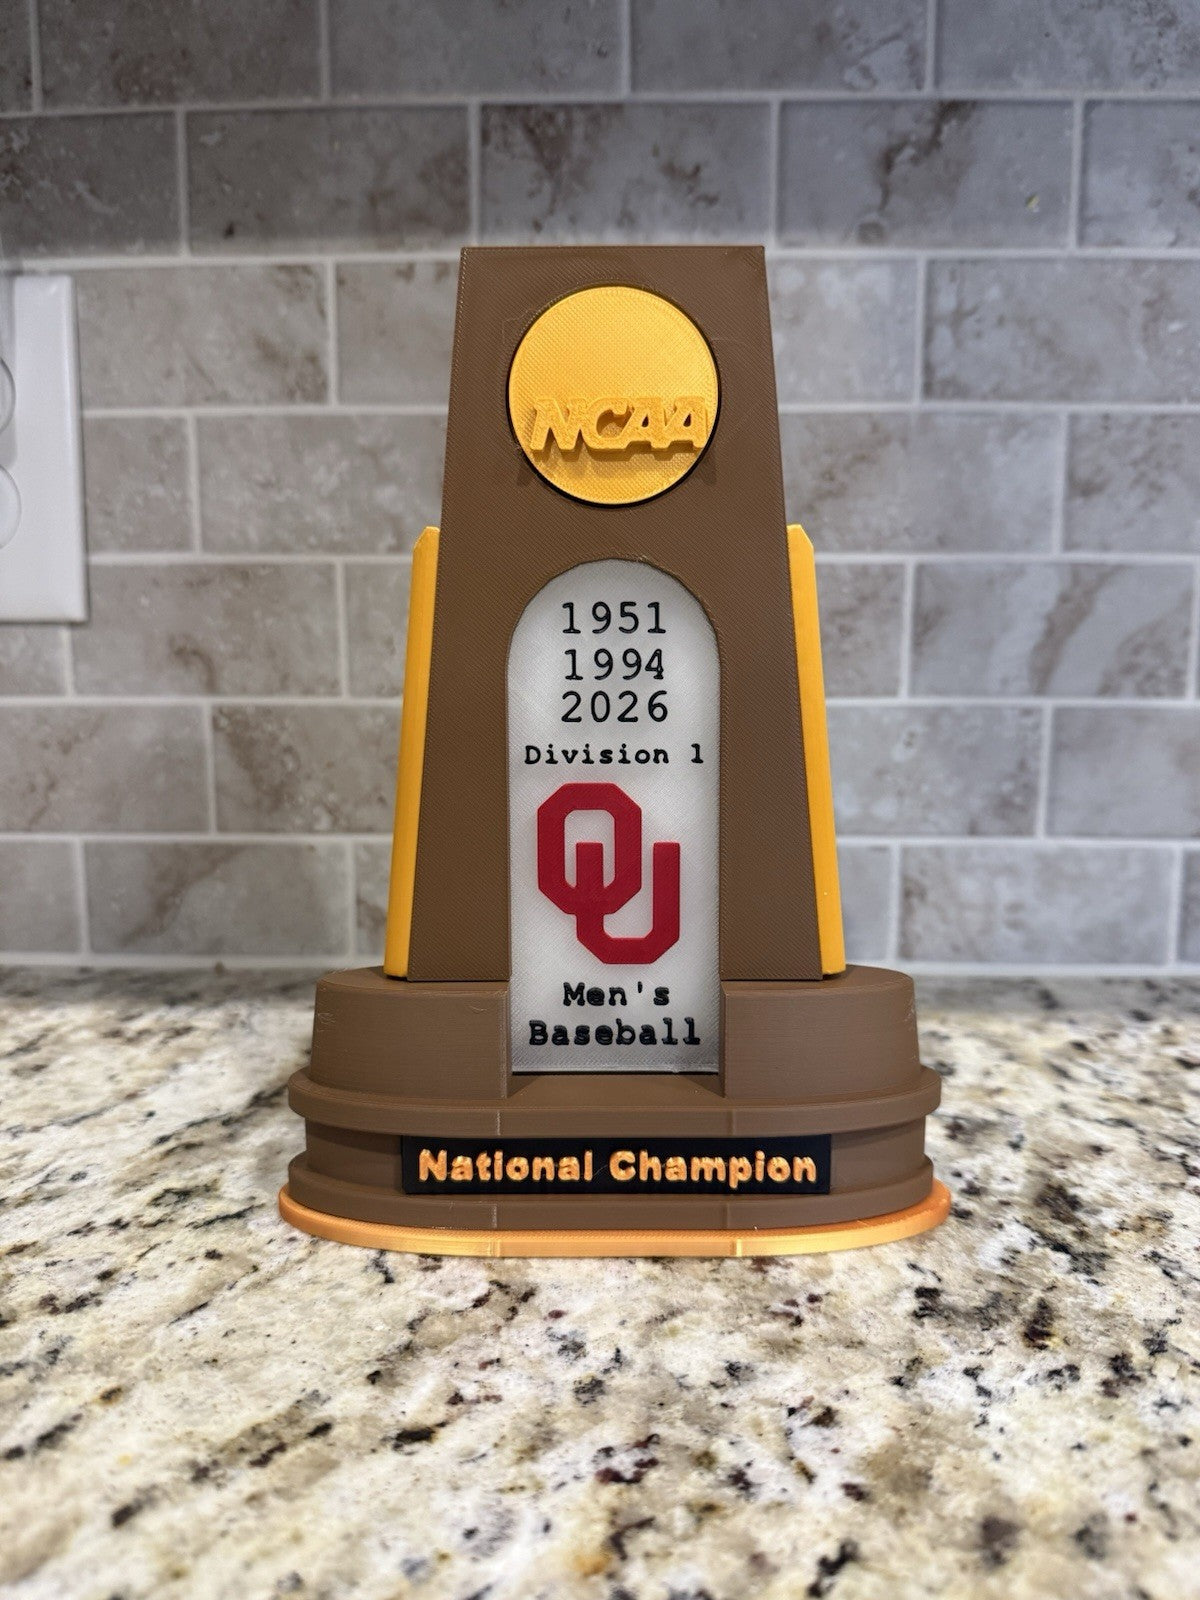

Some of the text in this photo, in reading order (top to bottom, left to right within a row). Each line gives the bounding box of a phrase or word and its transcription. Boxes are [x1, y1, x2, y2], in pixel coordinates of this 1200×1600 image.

[530, 397, 707, 454] NCAA
[561, 601, 667, 635] 1951
[564, 648, 665, 681] 1994
[560, 690, 669, 723] 2026
[524, 743, 704, 765] Division 1
[538, 784, 681, 965] OU
[562, 982, 671, 1007] Men's
[529, 1017, 702, 1047] Baseball
[418, 1149, 818, 1190] National Champion
